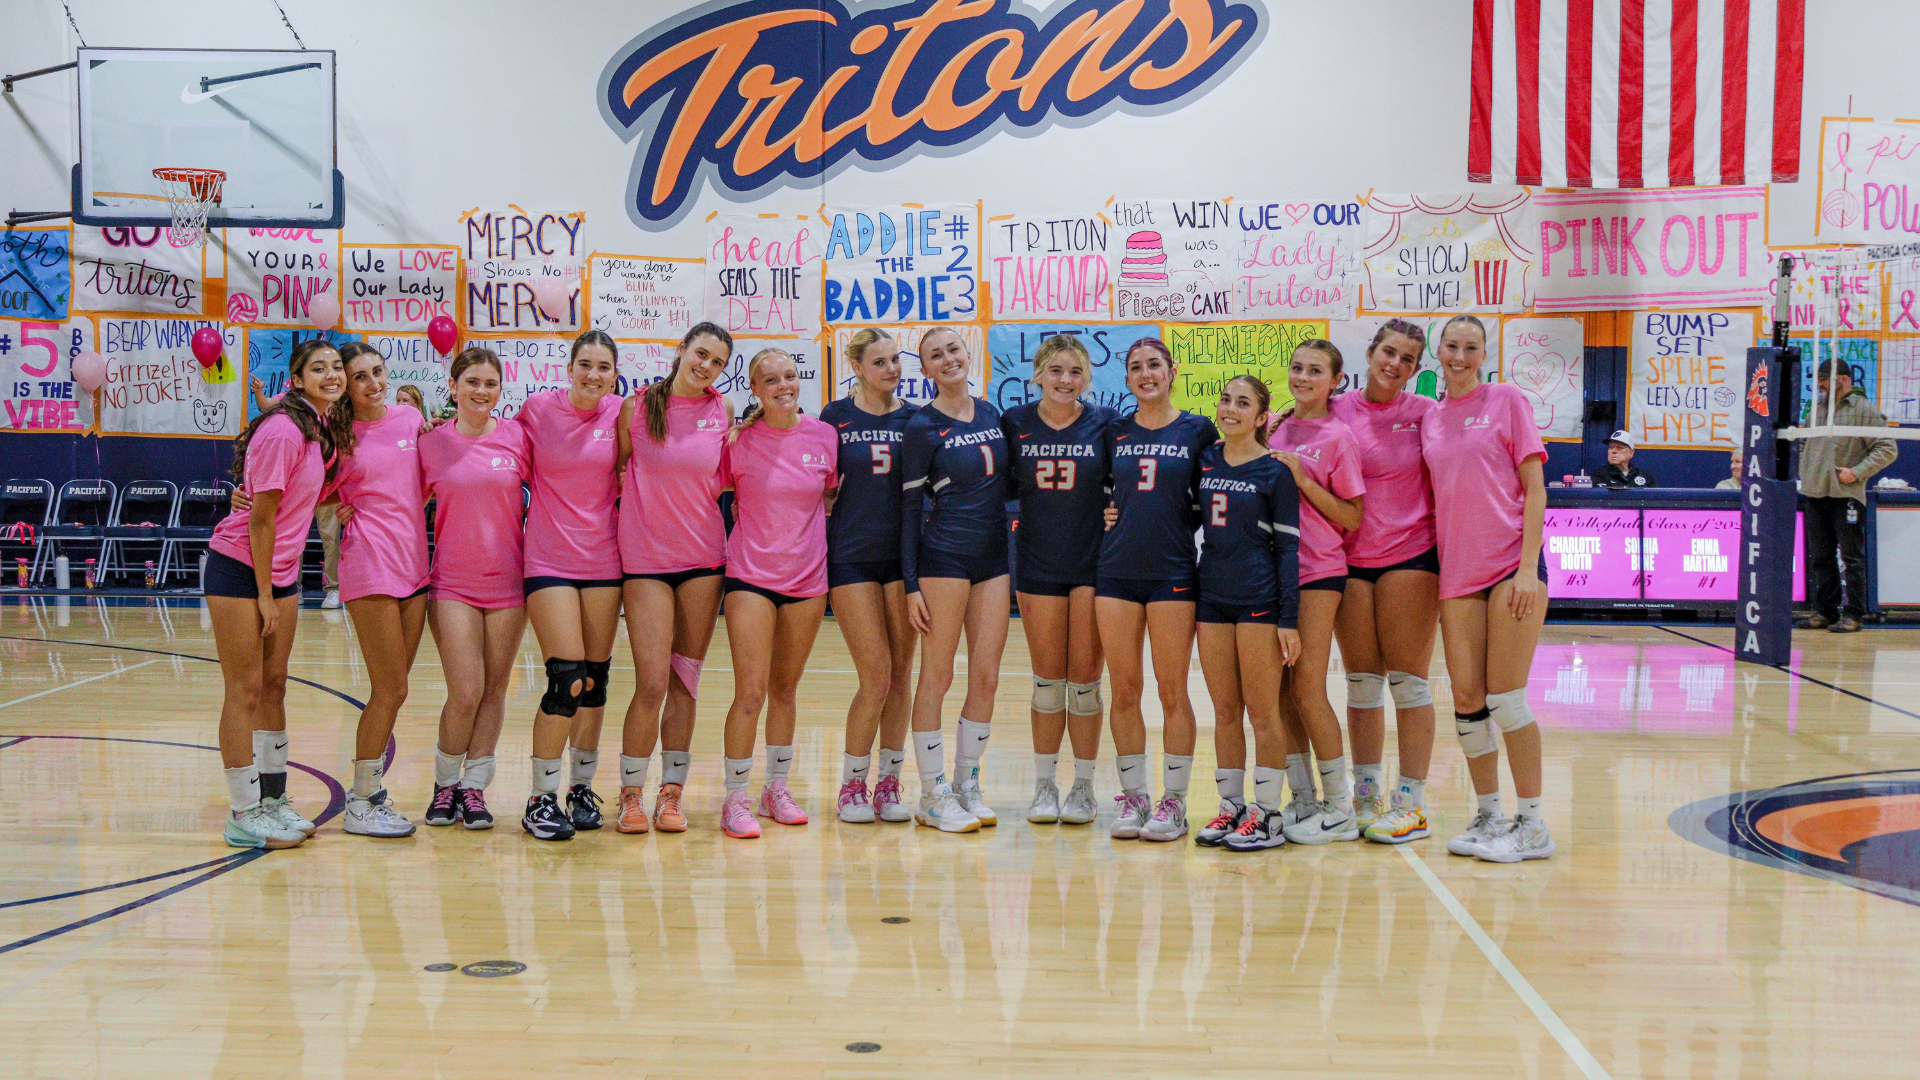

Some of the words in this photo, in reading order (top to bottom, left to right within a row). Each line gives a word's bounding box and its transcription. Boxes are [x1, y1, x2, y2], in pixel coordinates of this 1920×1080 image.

[622, 0, 1243, 205] Tritons
[1113, 200, 1155, 227] that
[1172, 201, 1228, 228] WIN
[1238, 203, 1281, 231] WE
[1313, 203, 1360, 226] OUR
[468, 213, 580, 260] MERCY
[713, 226, 821, 268] heal
[826, 210, 942, 260] ADDIE
[1001, 218, 1107, 252] TRITON
[1185, 240, 1218, 251] was
[1540, 216, 1647, 278] PINK
[1659, 211, 1759, 278] OUT
[248, 250, 314, 272] YOUR
[352, 249, 385, 273] We
[399, 250, 454, 272] LOVE
[876, 257, 914, 274] THE
[1243, 230, 1344, 281] Lady
[1397, 242, 1468, 276] SHOW
[1867, 247, 1900, 260] PACIFICA
[484, 261, 531, 279] Shows
[542, 264, 561, 277] No
[600, 258, 636, 278] you
[621, 271, 654, 280] want
[659, 273, 673, 282] to
[79, 257, 197, 309] tritons
[352, 277, 387, 297] Our
[399, 275, 444, 303] Lady
[625, 279, 655, 293] BLINK
[718, 267, 757, 297] SEALS
[770, 266, 801, 300] THE
[993, 254, 1109, 314] TAKEOVER
[1186, 281, 1198, 294] of
[1237, 274, 1351, 308] Tritons
[1397, 280, 1460, 309] TIME!
[1820, 275, 1869, 294] THE
[347, 298, 453, 323] TRITONS
[598, 293, 627, 304] when
[825, 275, 951, 322] BADDIE
[1118, 290, 1185, 317] Piece
[1192, 290, 1232, 316] CAKE
[616, 307, 633, 316] on
[641, 307, 661, 318] the
[621, 316, 656, 330] COURT
[728, 295, 808, 332] DEAL
[1646, 313, 1729, 336] BUMP
[106, 320, 151, 353] BEAR
[1657, 335, 1714, 356] SET
[516, 340, 539, 358] DO
[545, 343, 567, 358] IS
[1646, 355, 1726, 385] SPIKE
[13, 381, 30, 397] IS
[39, 381, 73, 399] THE
[104, 385, 128, 409] NO
[132, 376, 192, 405] JOKE!
[1647, 386, 1681, 408] LET'S
[1685, 387, 1708, 410] GET
[3, 399, 84, 429] VIBE
[840, 430, 903, 444] PACIFIC
[1642, 412, 1732, 442] HYPE
[870, 444, 893, 475] 5
[979, 444, 994, 476] 1
[1021, 444, 1095, 457] PACIFICA
[1115, 443, 1189, 459] PACIFICA
[1035, 460, 1076, 491] 23
[1137, 457, 1157, 492] 3
[6, 485, 43, 494] PACIFICA
[68, 487, 107, 495] PACIFICA
[130, 487, 168, 495] PACIFICA
[189, 487, 227, 496] PACIFICA
[1211, 492, 1228, 527] 2
[1648, 516, 1688, 530] Class
[1692, 517, 1710, 534] of
[1713, 520, 1741, 530] 202
[1549, 536, 1601, 554] CHARLOTTE
[1691, 538, 1720, 555] EMMA
[1743, 424, 1763, 654] PACIFICA
[1560, 553, 1592, 570] BOOTH
[1683, 555, 1728, 572] HARTMAN
[1565, 573, 1588, 586] #3
[1698, 576, 1718, 588] #1
